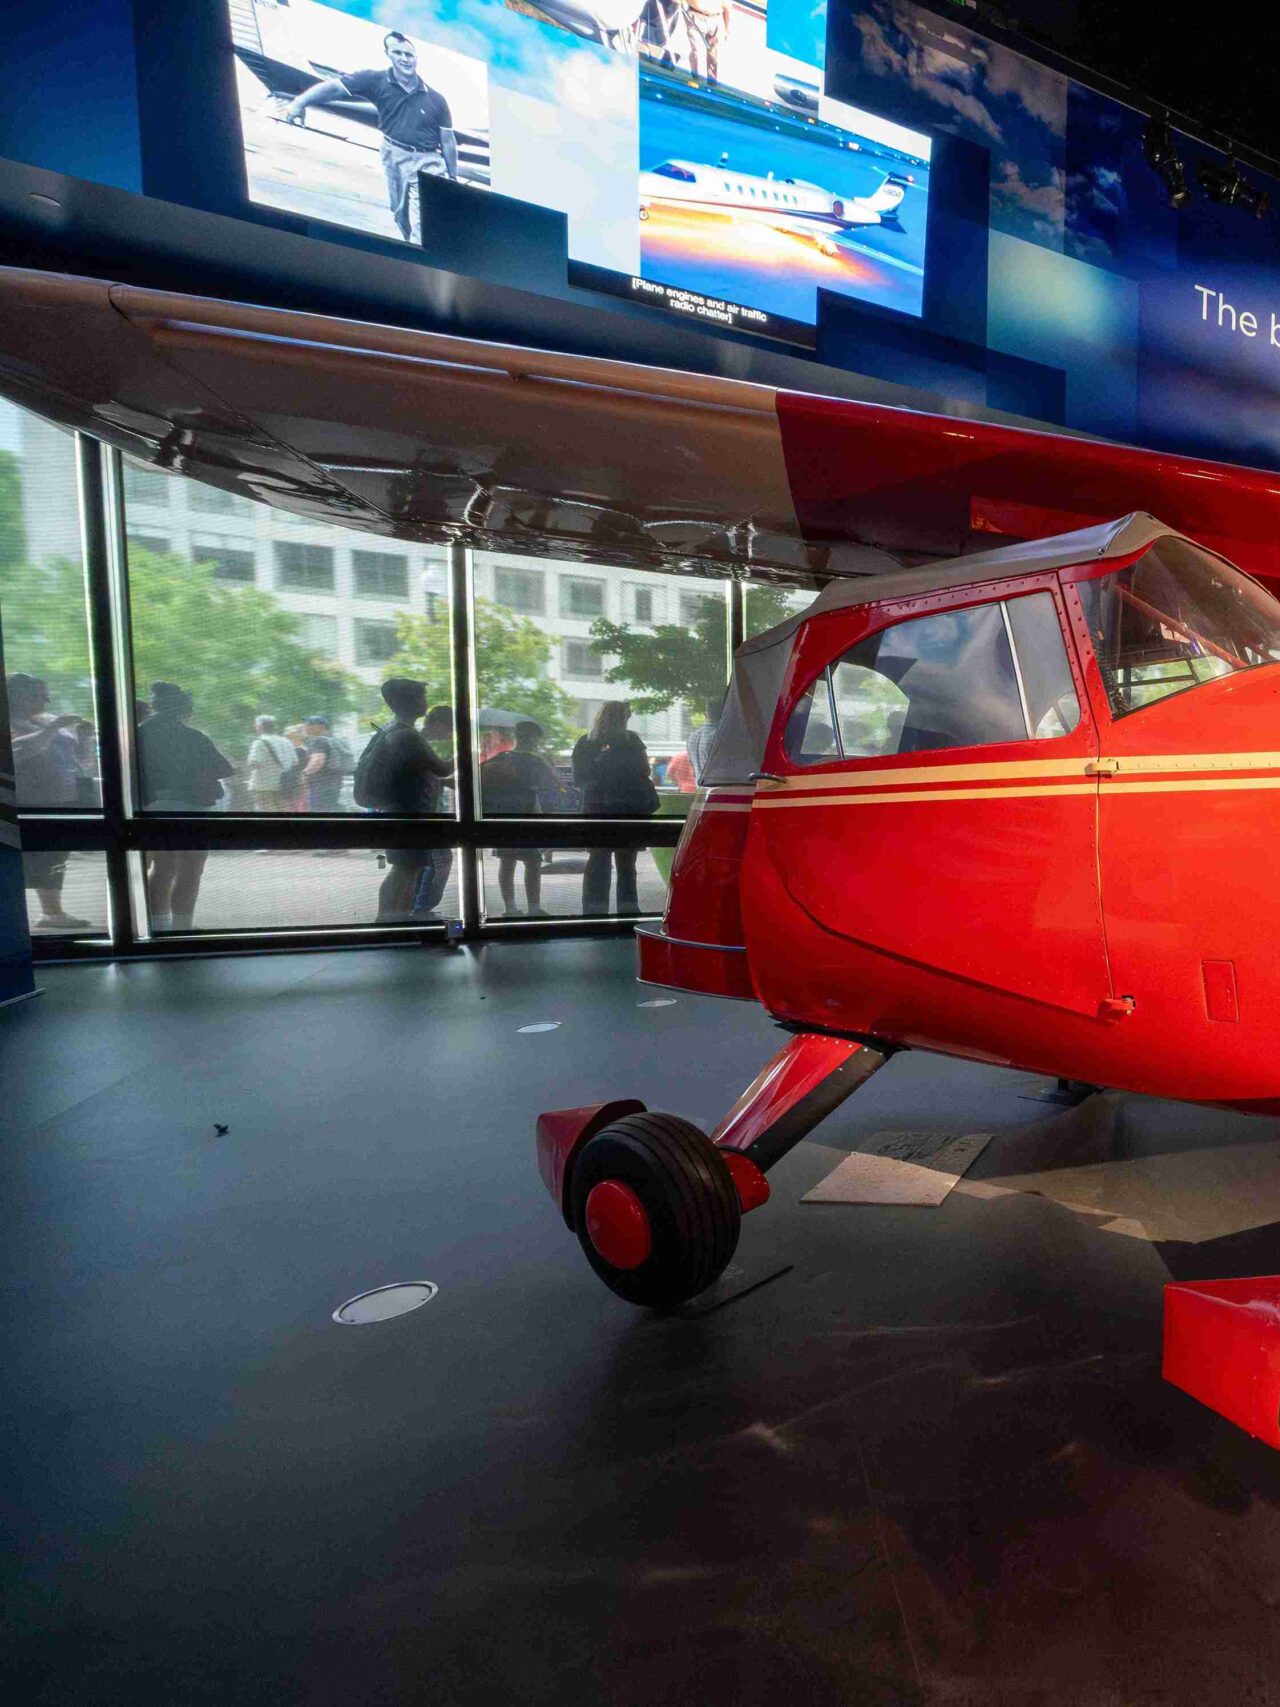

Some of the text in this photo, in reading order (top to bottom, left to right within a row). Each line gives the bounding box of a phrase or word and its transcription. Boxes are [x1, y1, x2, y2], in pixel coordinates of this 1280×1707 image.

[666, 288, 705, 305] engines
[706, 299, 725, 311] and
[726, 304, 739, 314] air
[741, 307, 767, 322] traffic
[669, 299, 695, 312] radio
[1194, 284, 1258, 337] The
